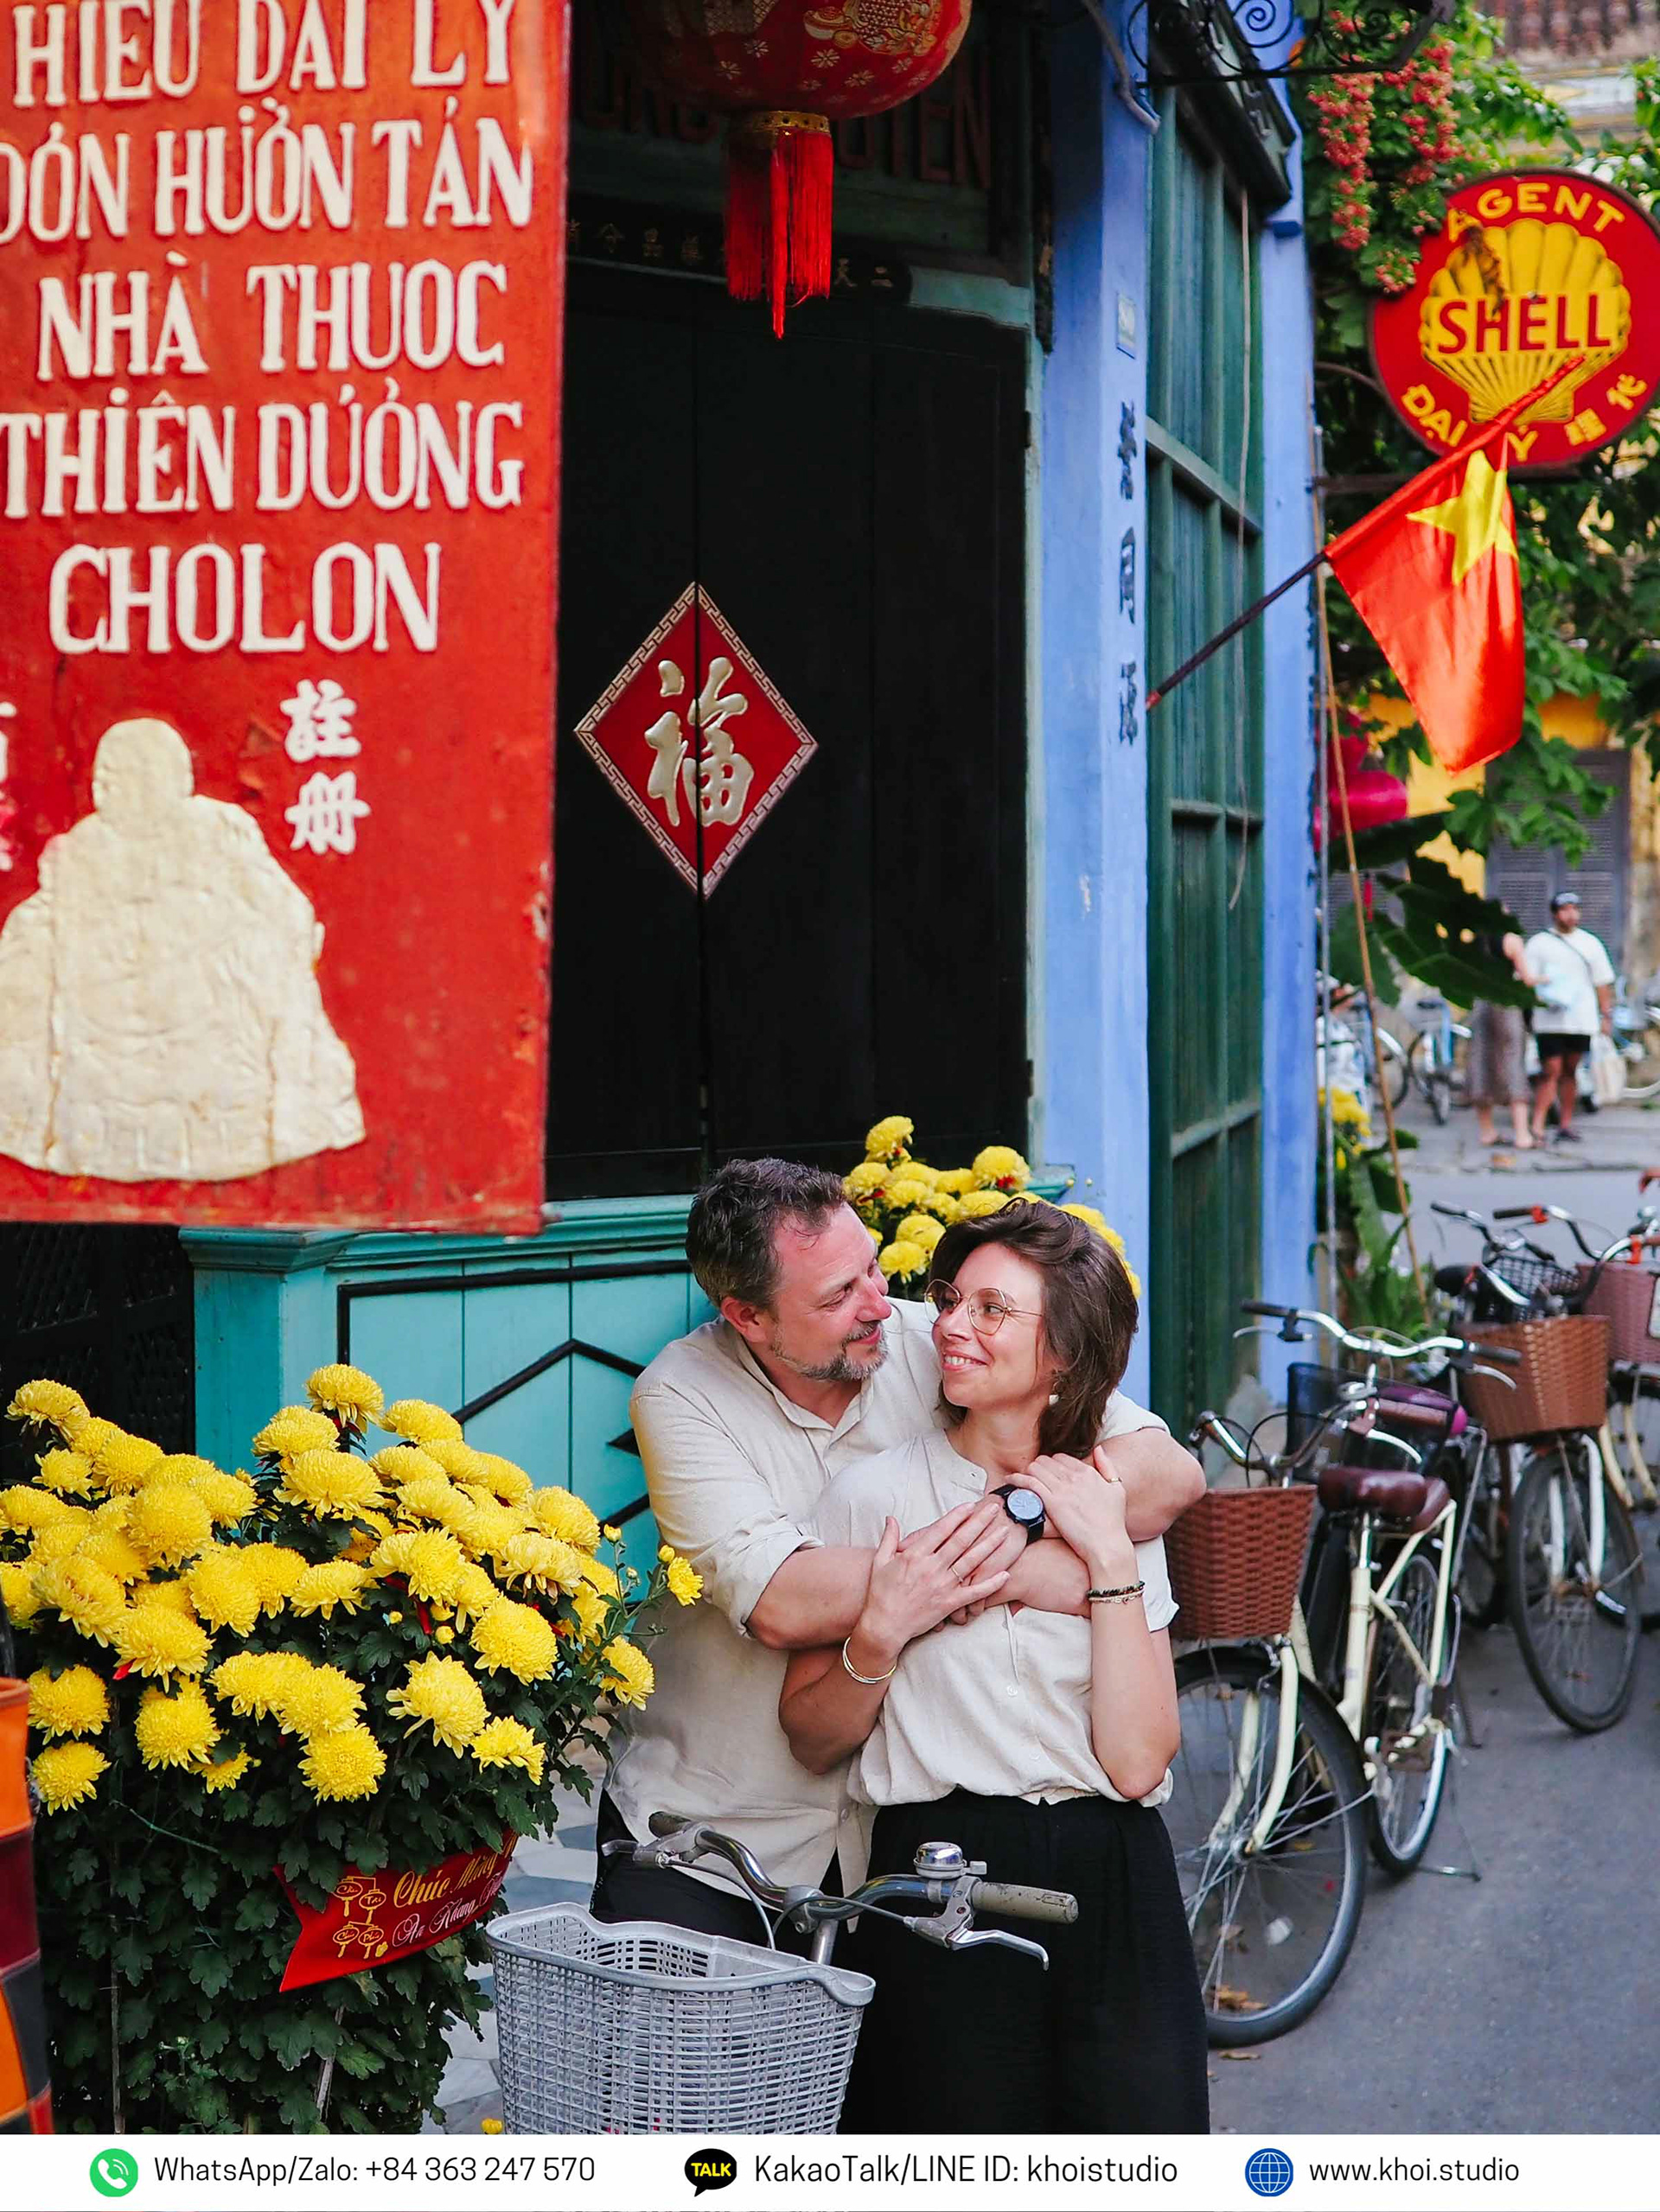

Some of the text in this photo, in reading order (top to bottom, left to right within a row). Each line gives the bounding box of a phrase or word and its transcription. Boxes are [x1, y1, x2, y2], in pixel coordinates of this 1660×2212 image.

[1447, 182, 1626, 243] AGENT
[38, 252, 208, 380] NHÀ
[1438, 294, 1611, 354] SHELL
[49, 542, 441, 654] CHOLON
[644, 656, 755, 828] 福
